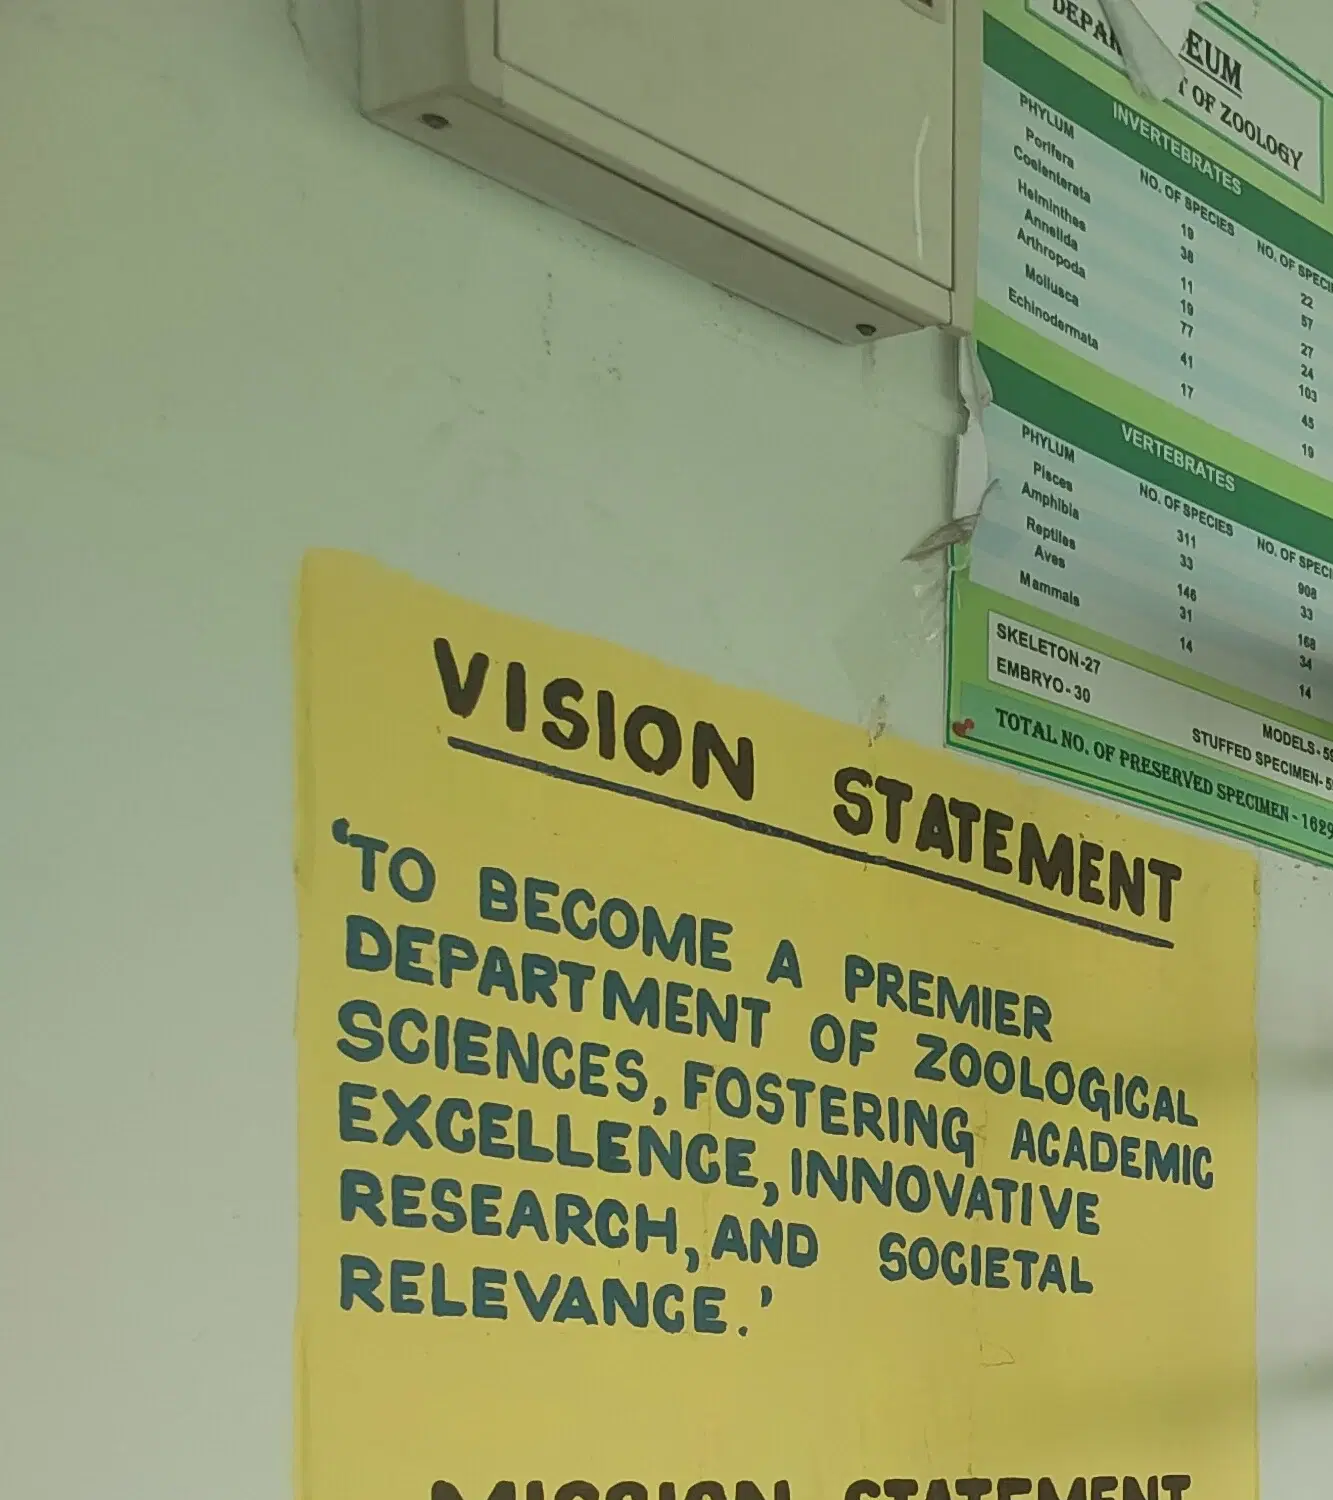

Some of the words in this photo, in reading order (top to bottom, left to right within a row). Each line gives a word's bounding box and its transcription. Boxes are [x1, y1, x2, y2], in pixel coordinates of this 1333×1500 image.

[1019, 93, 1075, 139] PHYLUM
[1112, 101, 1242, 196] INVERTEBRATES
[1191, 79, 1216, 113] OF
[1220, 100, 1303, 171] ZOOLOGY
[1012, 145, 1092, 204] Coelenterata
[1179, 247, 1195, 265] 38
[1300, 315, 1314, 331] 57
[1017, 178, 1087, 232] Helminthes
[1180, 277, 1194, 295] 11
[1299, 343, 1314, 358] 27
[1025, 127, 1075, 169] Porifera
[1299, 293, 1314, 310] 22
[1139, 169, 1161, 194] NO.
[1164, 183, 1182, 205] OF
[1184, 195, 1236, 237] SPECIES
[1256, 239, 1277, 265] NO.
[1279, 253, 1296, 274] OF
[1016, 227, 1086, 280] Arthropoda
[1179, 321, 1194, 338] 77
[1297, 385, 1317, 403] 103
[1023, 208, 1079, 252] Annelida
[1300, 364, 1314, 380] 24
[1024, 264, 1080, 307] Mollusca
[1179, 353, 1194, 370] 41
[1300, 414, 1315, 430] 45
[1007, 286, 1100, 352] Echinodermata
[1179, 383, 1195, 400] 17
[1300, 443, 1315, 460] 19
[1021, 424, 1076, 464] PHYLUM
[1120, 422, 1236, 493] VERTEBRATES
[1021, 482, 1081, 521] Amphibia
[1179, 554, 1194, 571] 33
[1300, 606, 1314, 621] 33
[1025, 515, 1077, 550] Reptiles
[1032, 460, 1074, 492] Pisces
[1176, 528, 1197, 550] 311
[1297, 581, 1318, 600] 908
[1139, 482, 1160, 506] NO.
[1163, 495, 1180, 515] OF
[1182, 503, 1235, 537] SPECIES
[1256, 536, 1277, 560] NO.
[1280, 548, 1297, 568] OF
[1018, 570, 1081, 607] Mammals
[1179, 636, 1193, 654] 14
[1298, 684, 1312, 700] 14
[1033, 545, 1066, 570] Aves
[1179, 606, 1193, 623] 31
[1299, 655, 1313, 671] 34
[432, 637, 757, 802] VISION
[831, 767, 1184, 923] STATEMENT
[995, 708, 1059, 744] TOTAL
[1061, 732, 1086, 753] NO.
[1093, 740, 1116, 763] OF
[1118, 750, 1214, 796] PRESERVED
[1215, 782, 1290, 823] SPECIMEN
[1192, 728, 1253, 763] STUFFED
[477, 865, 736, 975] BECOME
[766, 938, 803, 989] A
[843, 957, 1056, 1044] PREMIER
[344, 915, 772, 1050] DEPARTMENT
[809, 1015, 880, 1067] OF
[913, 1033, 1201, 1128] ZOOLOGICAL
[334, 1000, 670, 1117] SCIENCES,
[682, 1061, 976, 1168] FOSTERING
[1010, 1119, 1216, 1191] ACADEMIC
[336, 1081, 780, 1206] EXCELLENCE,
[789, 1148, 1103, 1237] INNOVATIVE
[336, 1168, 703, 1272] RESEARCH,
[710, 1214, 820, 1269] AND
[878, 1232, 1095, 1297] SOCIETAL
